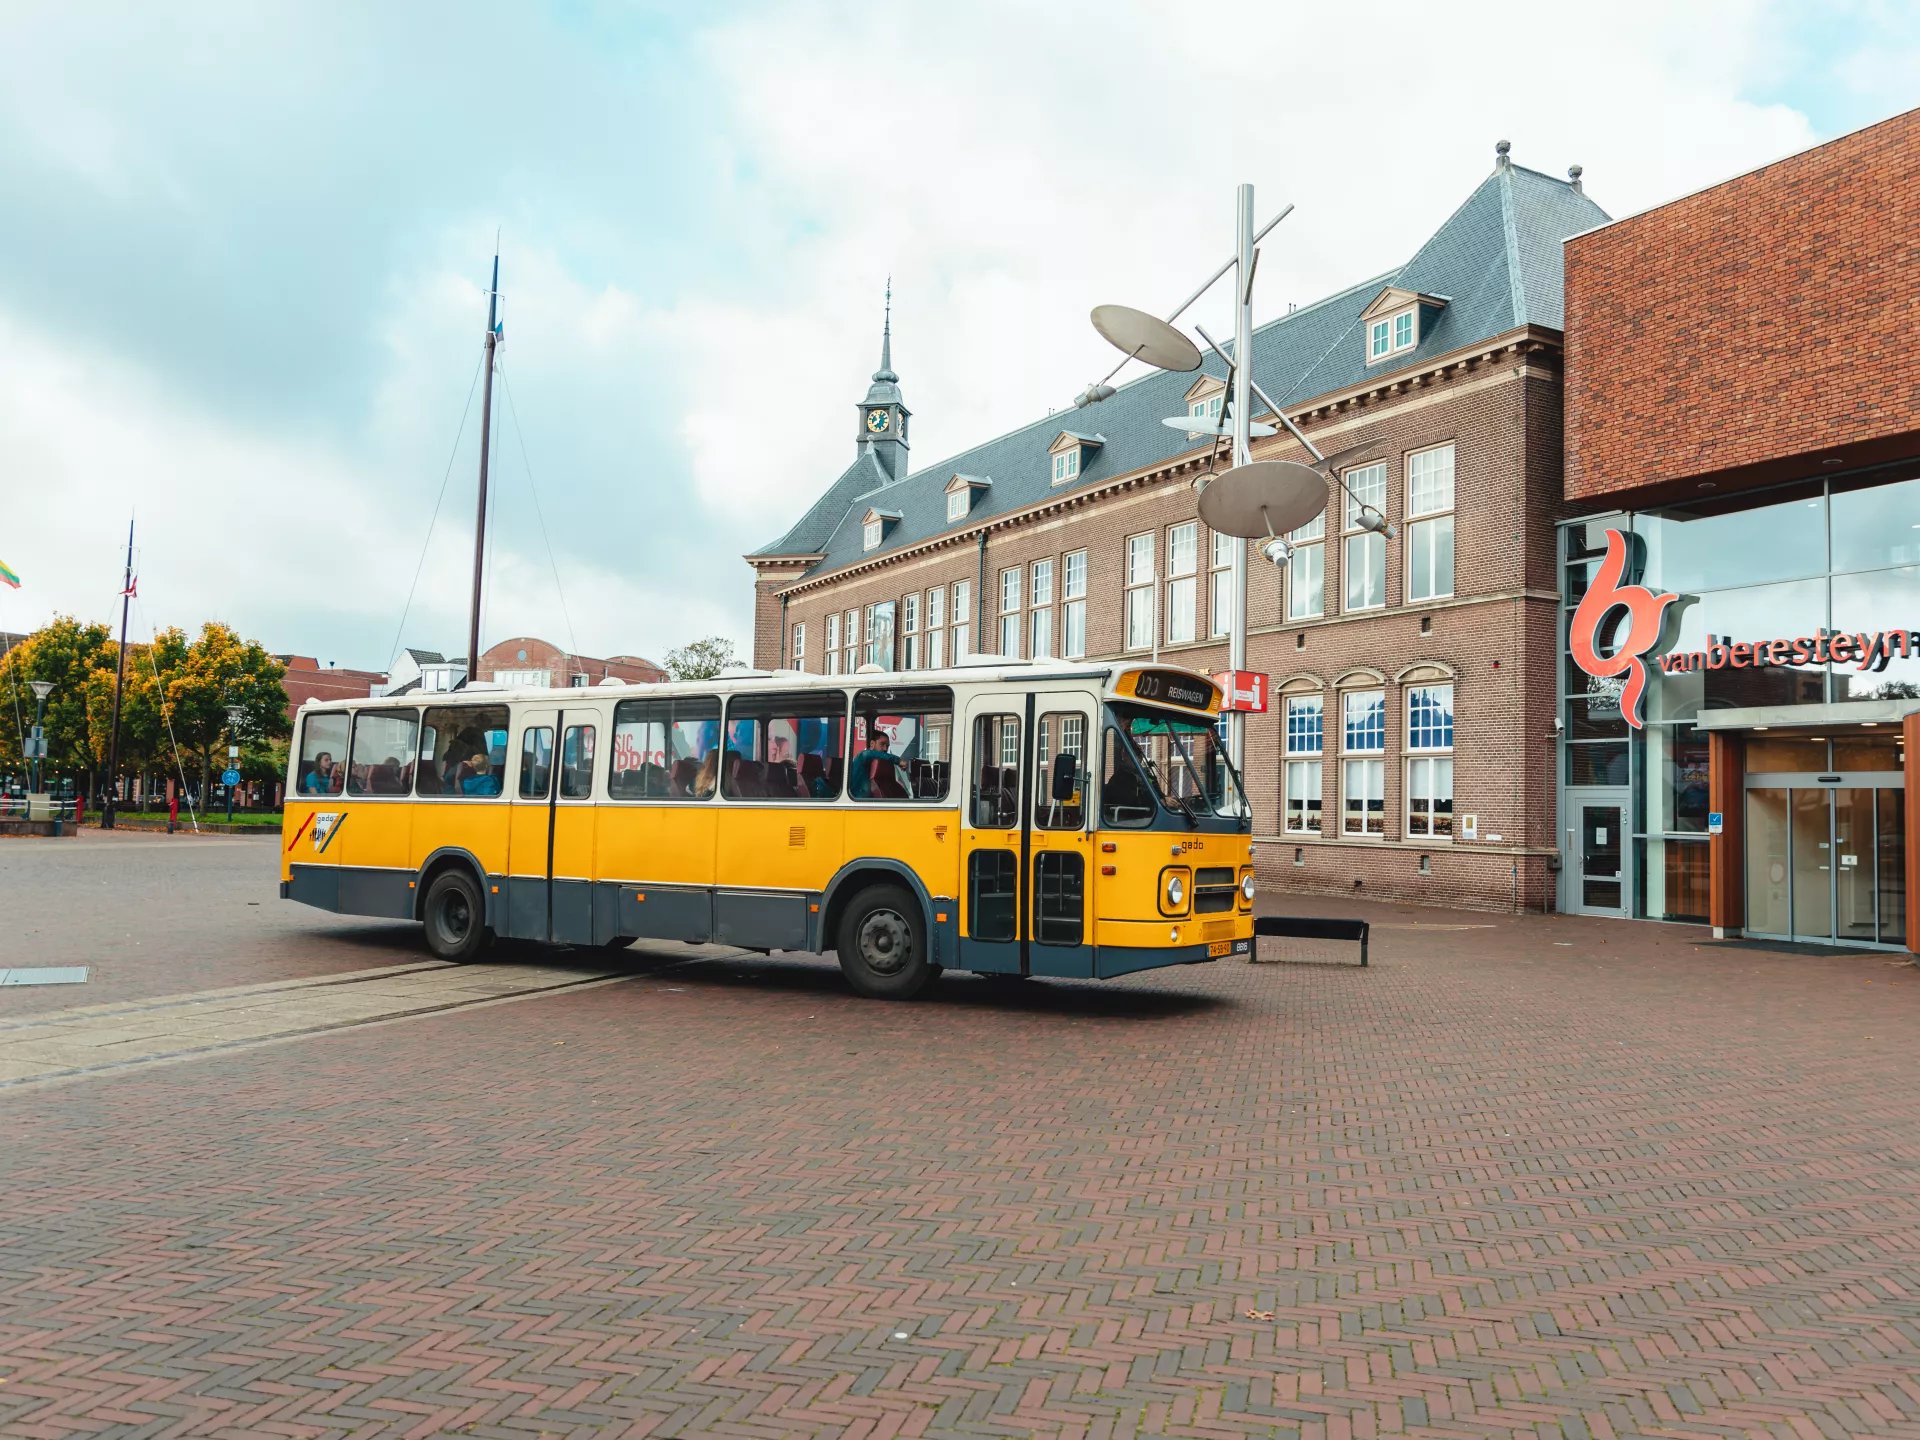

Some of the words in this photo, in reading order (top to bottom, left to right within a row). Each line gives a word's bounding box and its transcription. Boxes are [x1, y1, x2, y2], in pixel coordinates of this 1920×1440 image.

[1167, 686, 1204, 703] REISWAGEN
[316, 814, 334, 824] gado
[1181, 837, 1204, 854] gado
